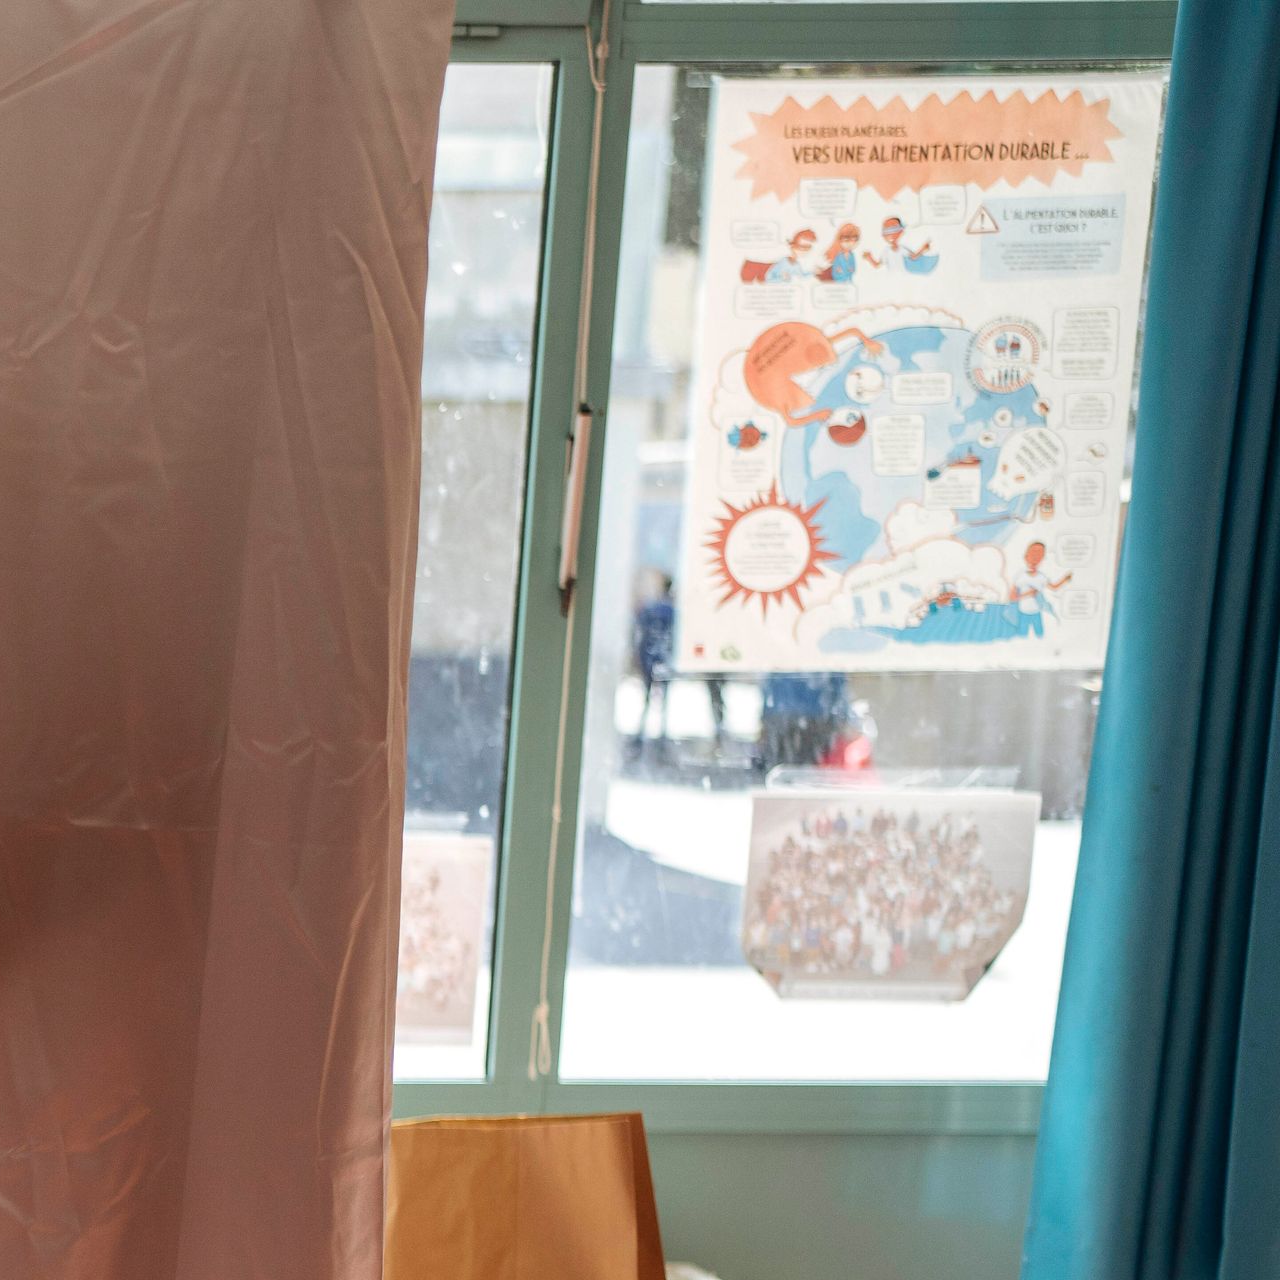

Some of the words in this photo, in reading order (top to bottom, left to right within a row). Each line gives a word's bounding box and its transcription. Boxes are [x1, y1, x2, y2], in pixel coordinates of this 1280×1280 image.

[792, 145, 831, 164] VERS
[834, 144, 866, 163] UNE
[999, 140, 1072, 161] DURABLE
